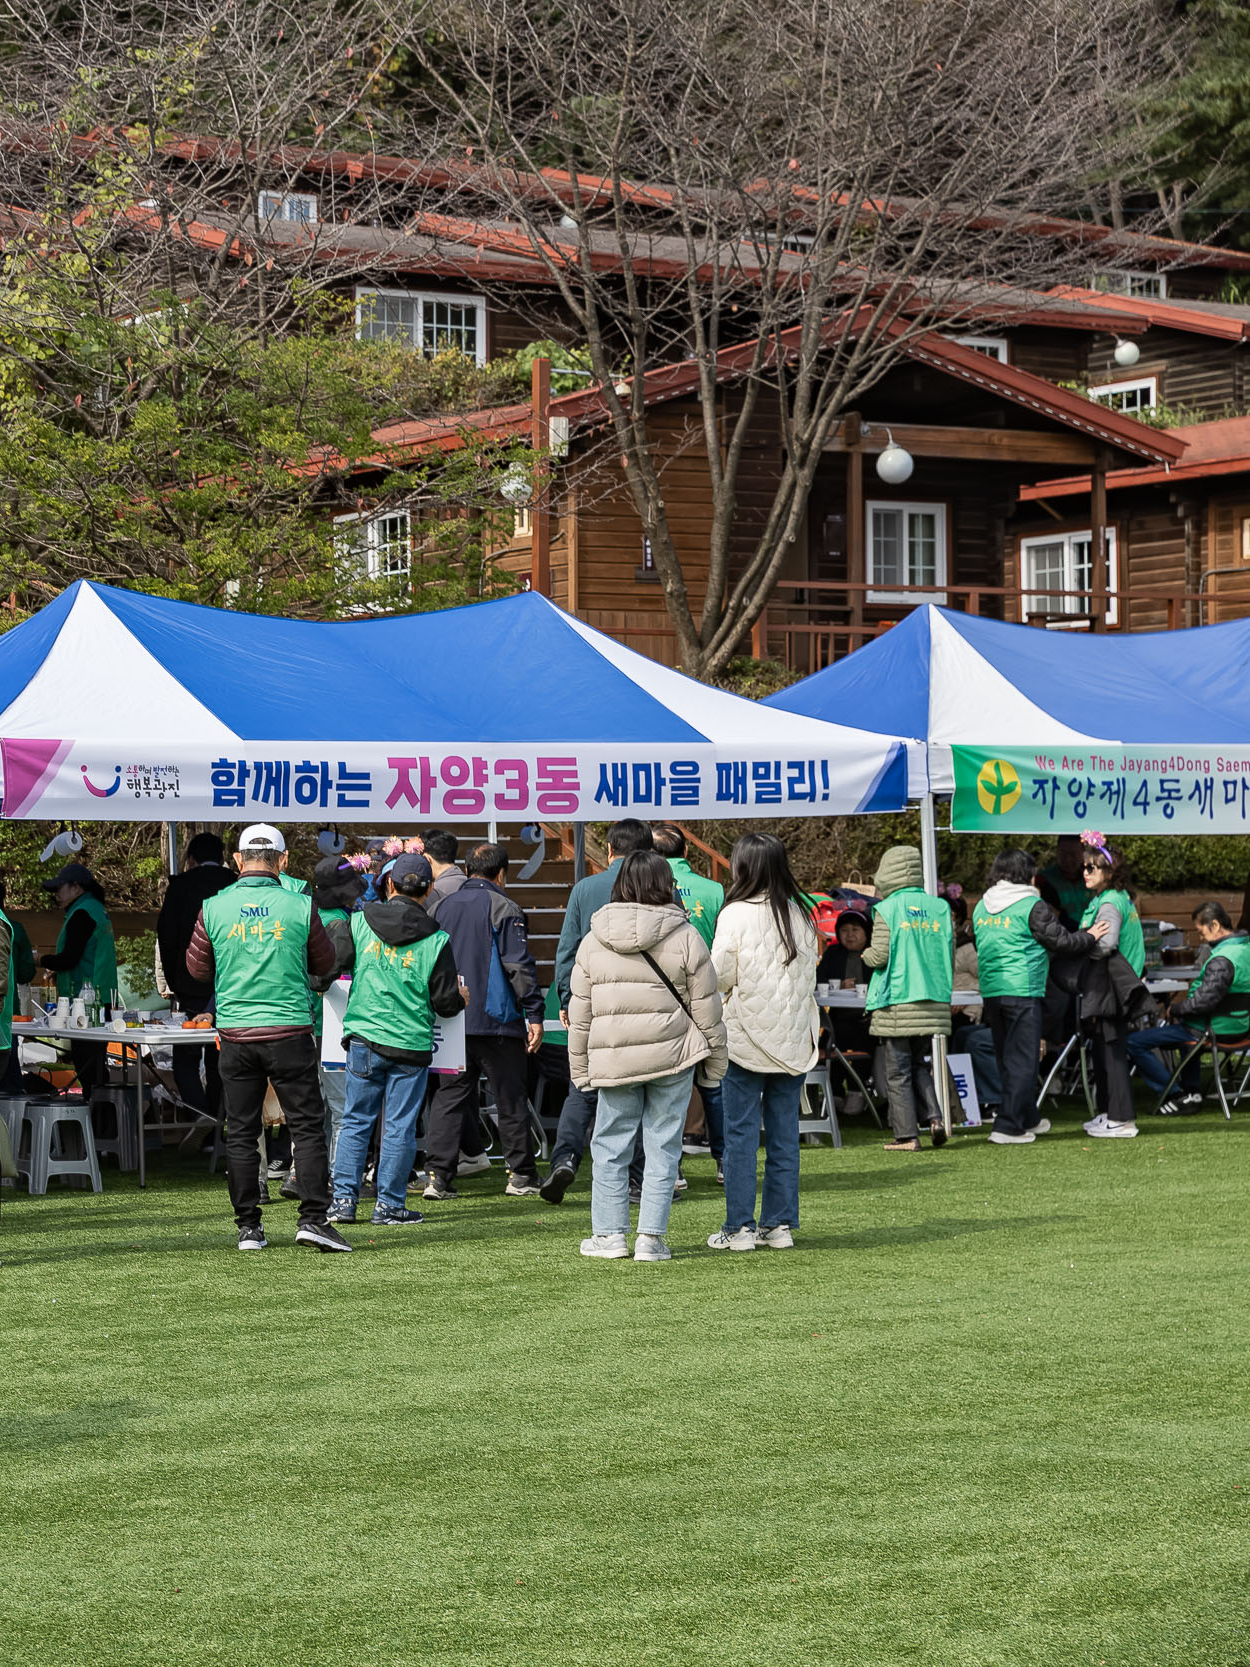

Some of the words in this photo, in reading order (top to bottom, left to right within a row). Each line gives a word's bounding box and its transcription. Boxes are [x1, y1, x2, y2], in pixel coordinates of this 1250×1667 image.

[126, 764, 152, 778] 소통하며
[1035, 755, 1055, 771] We
[1062, 755, 1084, 771] Are
[1090, 755, 1114, 771] The
[1120, 755, 1210, 774] Jayang4Dong
[126, 776, 180, 800] 행복광진
[210, 757, 373, 808] 함께하는
[384, 755, 581, 815] 자양3동
[593, 760, 702, 807] 새마을
[715, 759, 830, 805] 패밀리!
[240, 906, 269, 918] SMU
[227, 920, 286, 942] 새마을
[363, 940, 415, 969] 새마을
